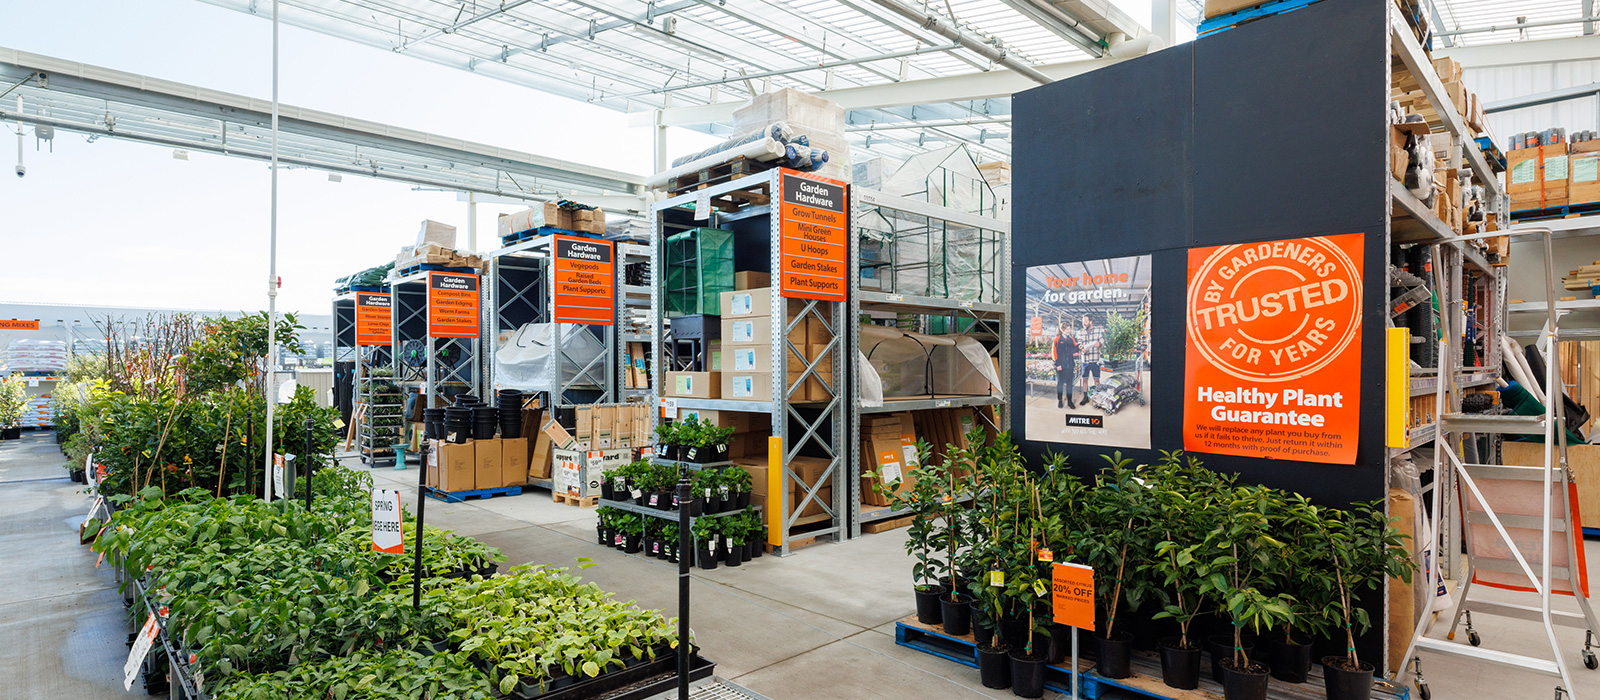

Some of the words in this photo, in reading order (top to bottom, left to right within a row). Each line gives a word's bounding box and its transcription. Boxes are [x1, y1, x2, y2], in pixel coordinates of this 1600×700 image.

[800, 182, 828, 196] Garden
[796, 192, 833, 208] Hardware
[792, 208, 811, 218] Grow
[811, 210, 836, 223] Tunnels
[798, 224, 812, 232] Mini
[813, 225, 832, 236] Green
[804, 232, 826, 242] Houses
[572, 243, 597, 253] Garden
[800, 244, 806, 252] U
[807, 245, 828, 256] Hoops
[567, 250, 601, 260] Hardware
[570, 262, 599, 270] Vegepods
[790, 260, 816, 270] Garden
[817, 262, 838, 273] Stakes
[1204, 279, 1225, 303] BY
[1218, 242, 1336, 280] GARDENERS
[790, 276, 808, 287] Plant
[809, 278, 838, 290] Supports
[1045, 275, 1079, 288] Your
[1083, 272, 1128, 286] home
[580, 286, 606, 294] Supports
[1044, 289, 1065, 303] for
[1068, 287, 1127, 304] garden.
[1197, 278, 1348, 330] TRUSTED
[1219, 337, 1261, 365] FOR
[1269, 317, 1336, 366] YEARS
[1198, 386, 1278, 408] Healthy
[1283, 389, 1343, 408] Plant
[1211, 406, 1325, 427] Guarantee
[1304, 431, 1320, 439] buy
[1316, 440, 1343, 448] within
[1292, 447, 1330, 456] purchase.
[383, 522, 399, 532] HERE
[1054, 584, 1071, 594] 20%
[1074, 588, 1092, 597] OFF
